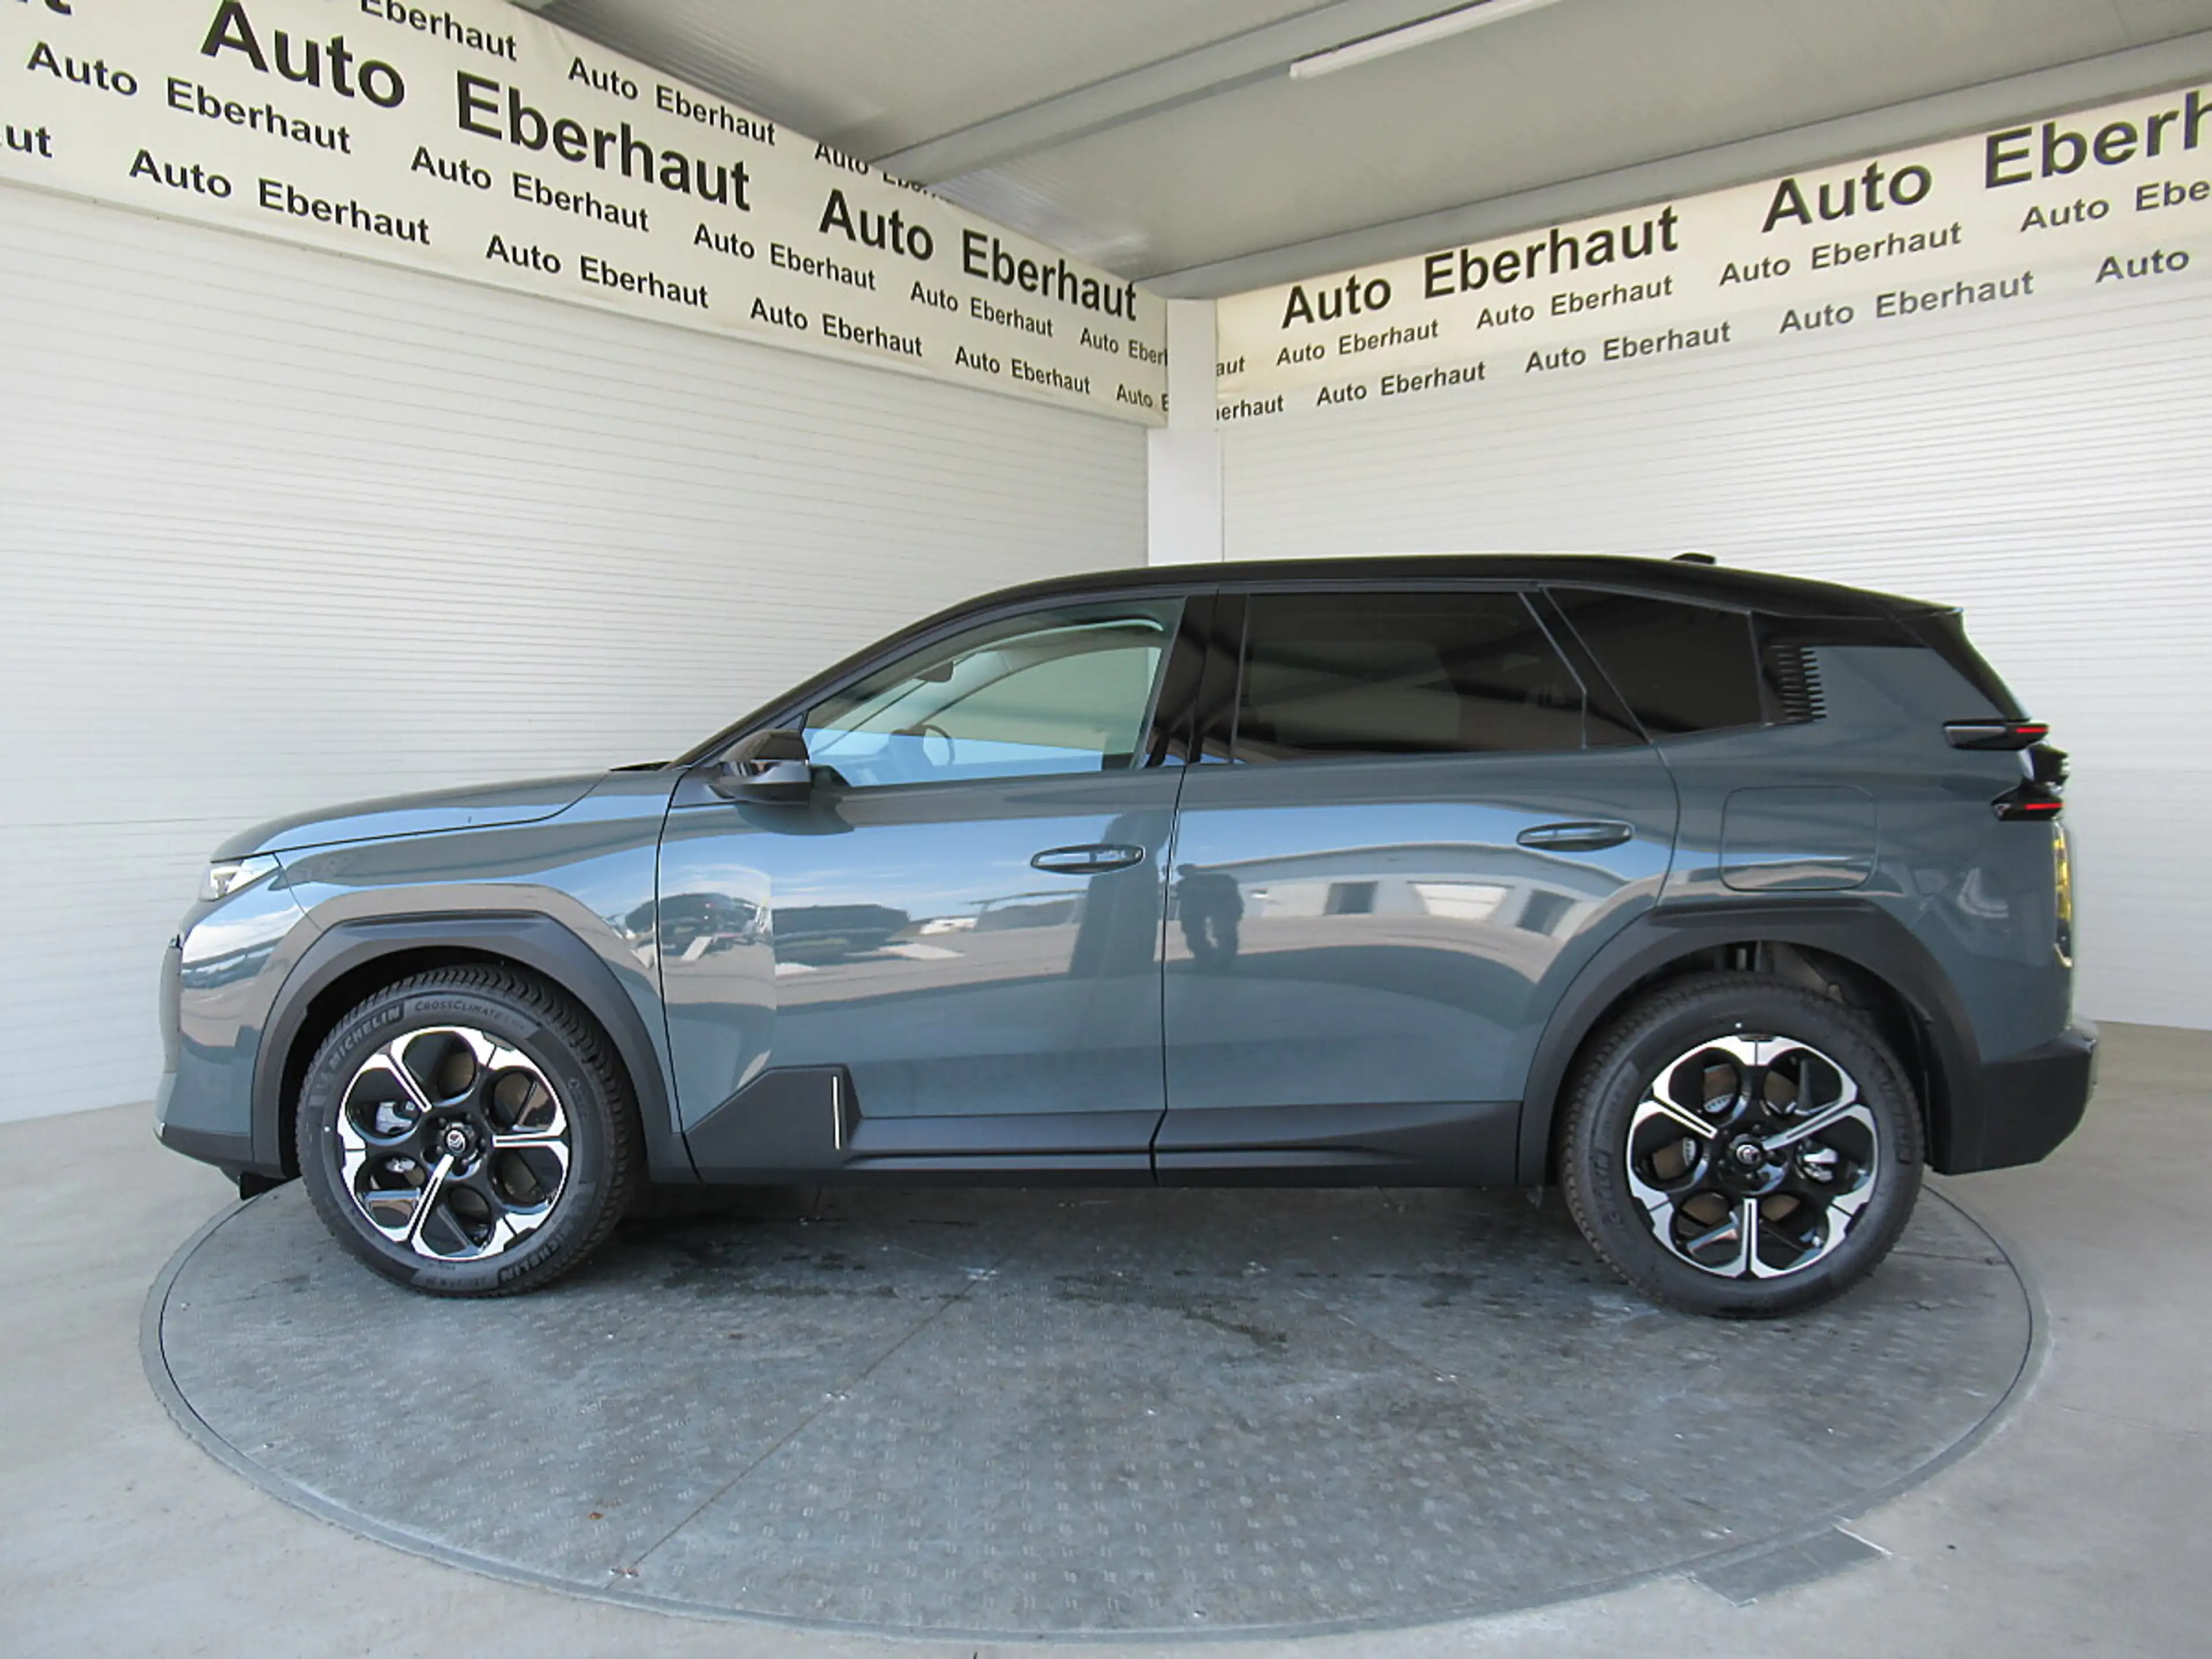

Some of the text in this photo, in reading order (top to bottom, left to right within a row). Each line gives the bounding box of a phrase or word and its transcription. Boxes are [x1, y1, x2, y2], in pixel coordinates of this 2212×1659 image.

[362, 0, 516, 61] Eberhaut
[28, 42, 350, 154] Auto Eberhaut
[200, 0, 751, 211] Auto Eberhaut
[569, 57, 774, 146] Auto Eberhaut
[0, 124, 52, 157] ut
[1762, 90, 2212, 233] Auto Eberh
[130, 150, 429, 245] Auto Eberhaut
[411, 147, 648, 232] Auto Eberhaut
[2021, 181, 2210, 232] Auto Ebe
[487, 235, 708, 308] Auto Eberhaut
[694, 224, 875, 290] Auto Eberhaut
[819, 189, 1137, 321] Auto Eberhaut
[1282, 206, 1679, 328] Auto Eberhaut
[1720, 222, 1961, 286] Auto Eberhaut
[2096, 250, 2189, 282] Auto
[751, 298, 922, 357] Auto Eberhaut
[911, 282, 1052, 337] Auto Eberhaut
[1477, 276, 1672, 328] Auto Eberhaut
[1780, 271, 2033, 334] Auto Eberhaut
[956, 347, 1089, 394] Auto Eberhaut
[1081, 328, 1118, 353] Auto
[1277, 320, 1438, 365] Auto Eberhaut
[1525, 322, 1730, 373] Auto Eberhaut
[1117, 384, 1153, 408] Auto
[1216, 395, 1284, 421] erhaut
[1317, 362, 1484, 406] Auto Eberhaut
[329, 1005, 401, 1070] MICHELIN
